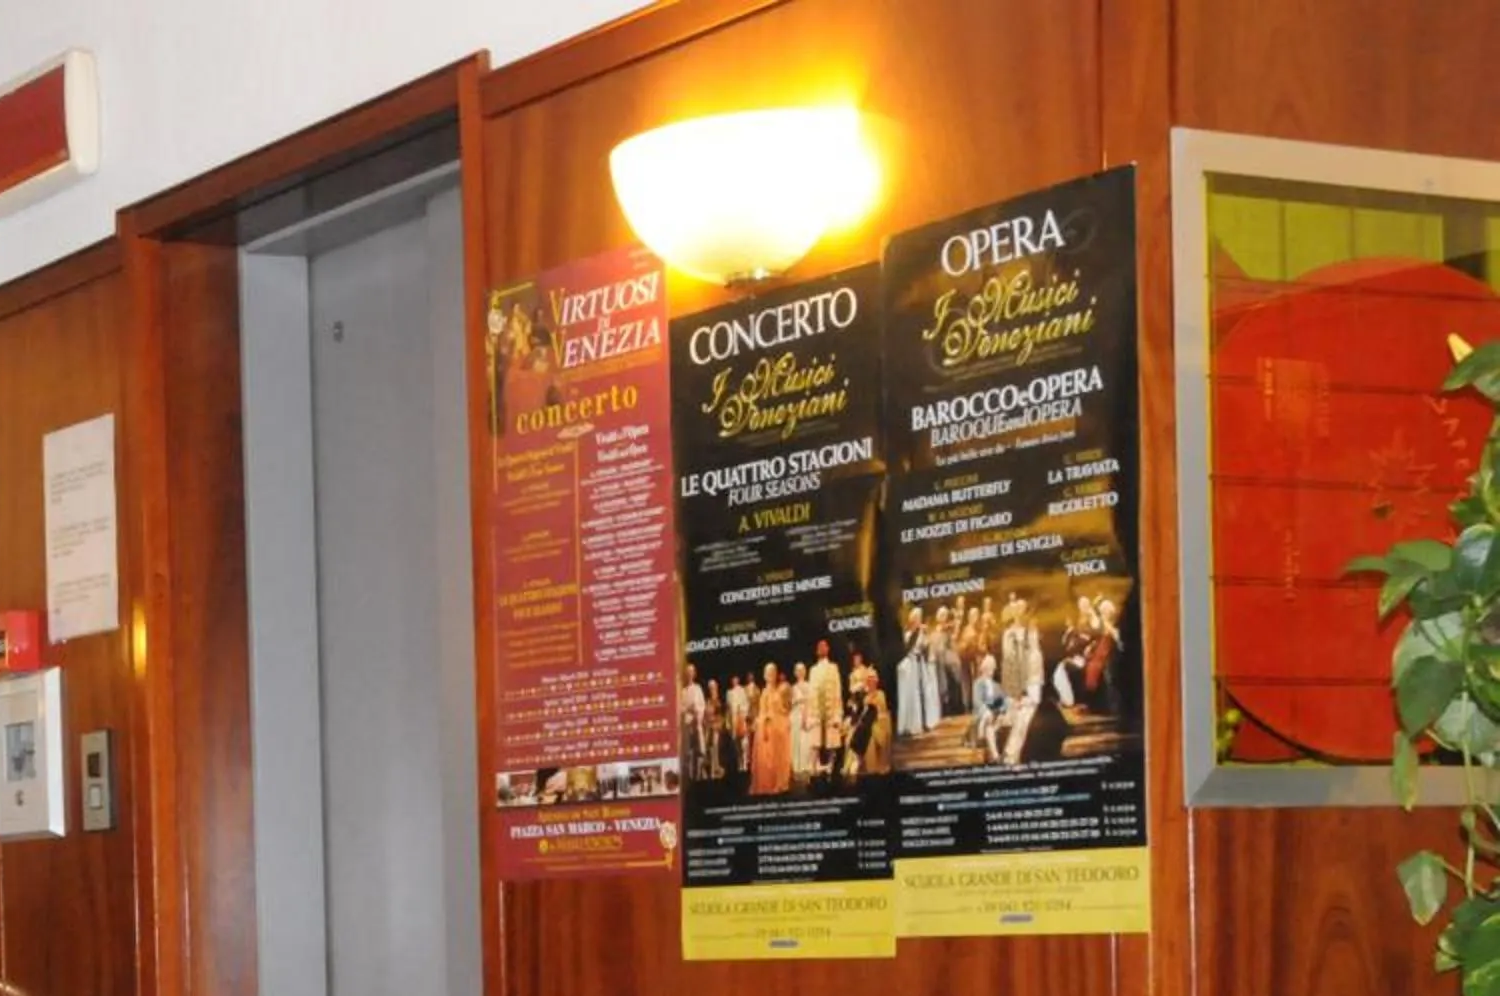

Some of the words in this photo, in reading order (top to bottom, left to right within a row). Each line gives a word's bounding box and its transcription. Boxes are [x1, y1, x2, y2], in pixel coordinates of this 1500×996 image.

[940, 209, 1066, 277] OPERA
[550, 271, 661, 327] VIRTUOSI
[967, 268, 1080, 327] Musici
[550, 316, 662, 369] VENEZIA
[689, 287, 858, 365] CONCERTO
[942, 296, 1098, 367] Veneziani
[740, 351, 836, 401] Musici
[515, 384, 639, 436] concerto
[718, 377, 850, 439] Veneziani
[681, 473, 700, 497] LE
[702, 456, 786, 496] QUATTRO
[788, 436, 873, 476] STAGIONI
[727, 484, 765, 507] FOUR
[765, 471, 821, 500] SEASONS
[951, 479, 1012, 503] BUTTERFLY
[1047, 470, 1063, 485] LA
[1066, 458, 1121, 481] TRAVIATA
[753, 502, 812, 530] VIVALDI
[900, 528, 913, 543] LE
[970, 511, 1013, 530] FIGARO
[1047, 491, 1120, 516] RIGOLETTO
[1015, 534, 1064, 554] SIVIGLIA
[1065, 558, 1107, 577] TOSCA
[902, 586, 929, 603] DON
[929, 577, 986, 599] GIOVANNI
